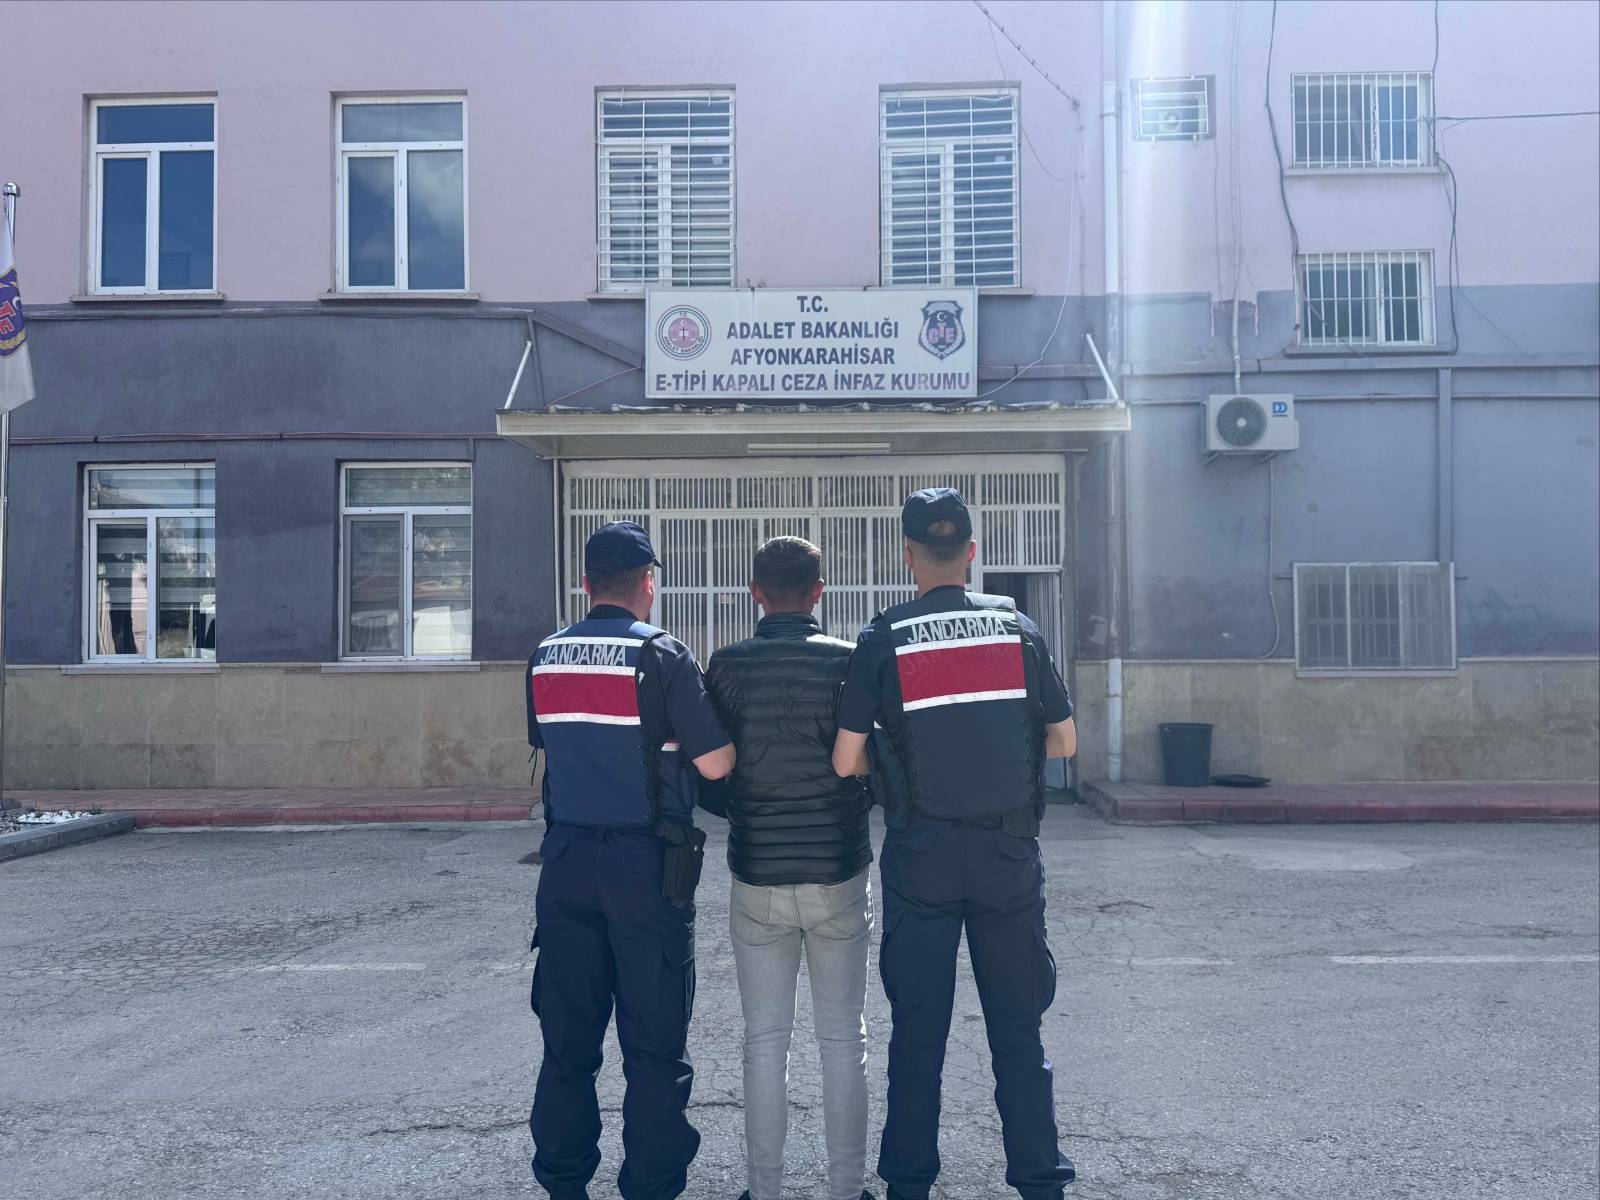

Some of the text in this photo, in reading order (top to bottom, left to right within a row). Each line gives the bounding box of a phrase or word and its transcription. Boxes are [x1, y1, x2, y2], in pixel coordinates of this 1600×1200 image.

[796, 295, 829, 313] T.C.
[726, 316, 899, 340] ADALET BAKANLIĞI
[730, 343, 896, 365] AFYONKARAHİSAR
[655, 369, 970, 391] E-TİPİ KAPALI CEZA İNFAZ KURUMU
[907, 616, 1008, 644] JANDARMA
[540, 643, 627, 667] JANDARMA
